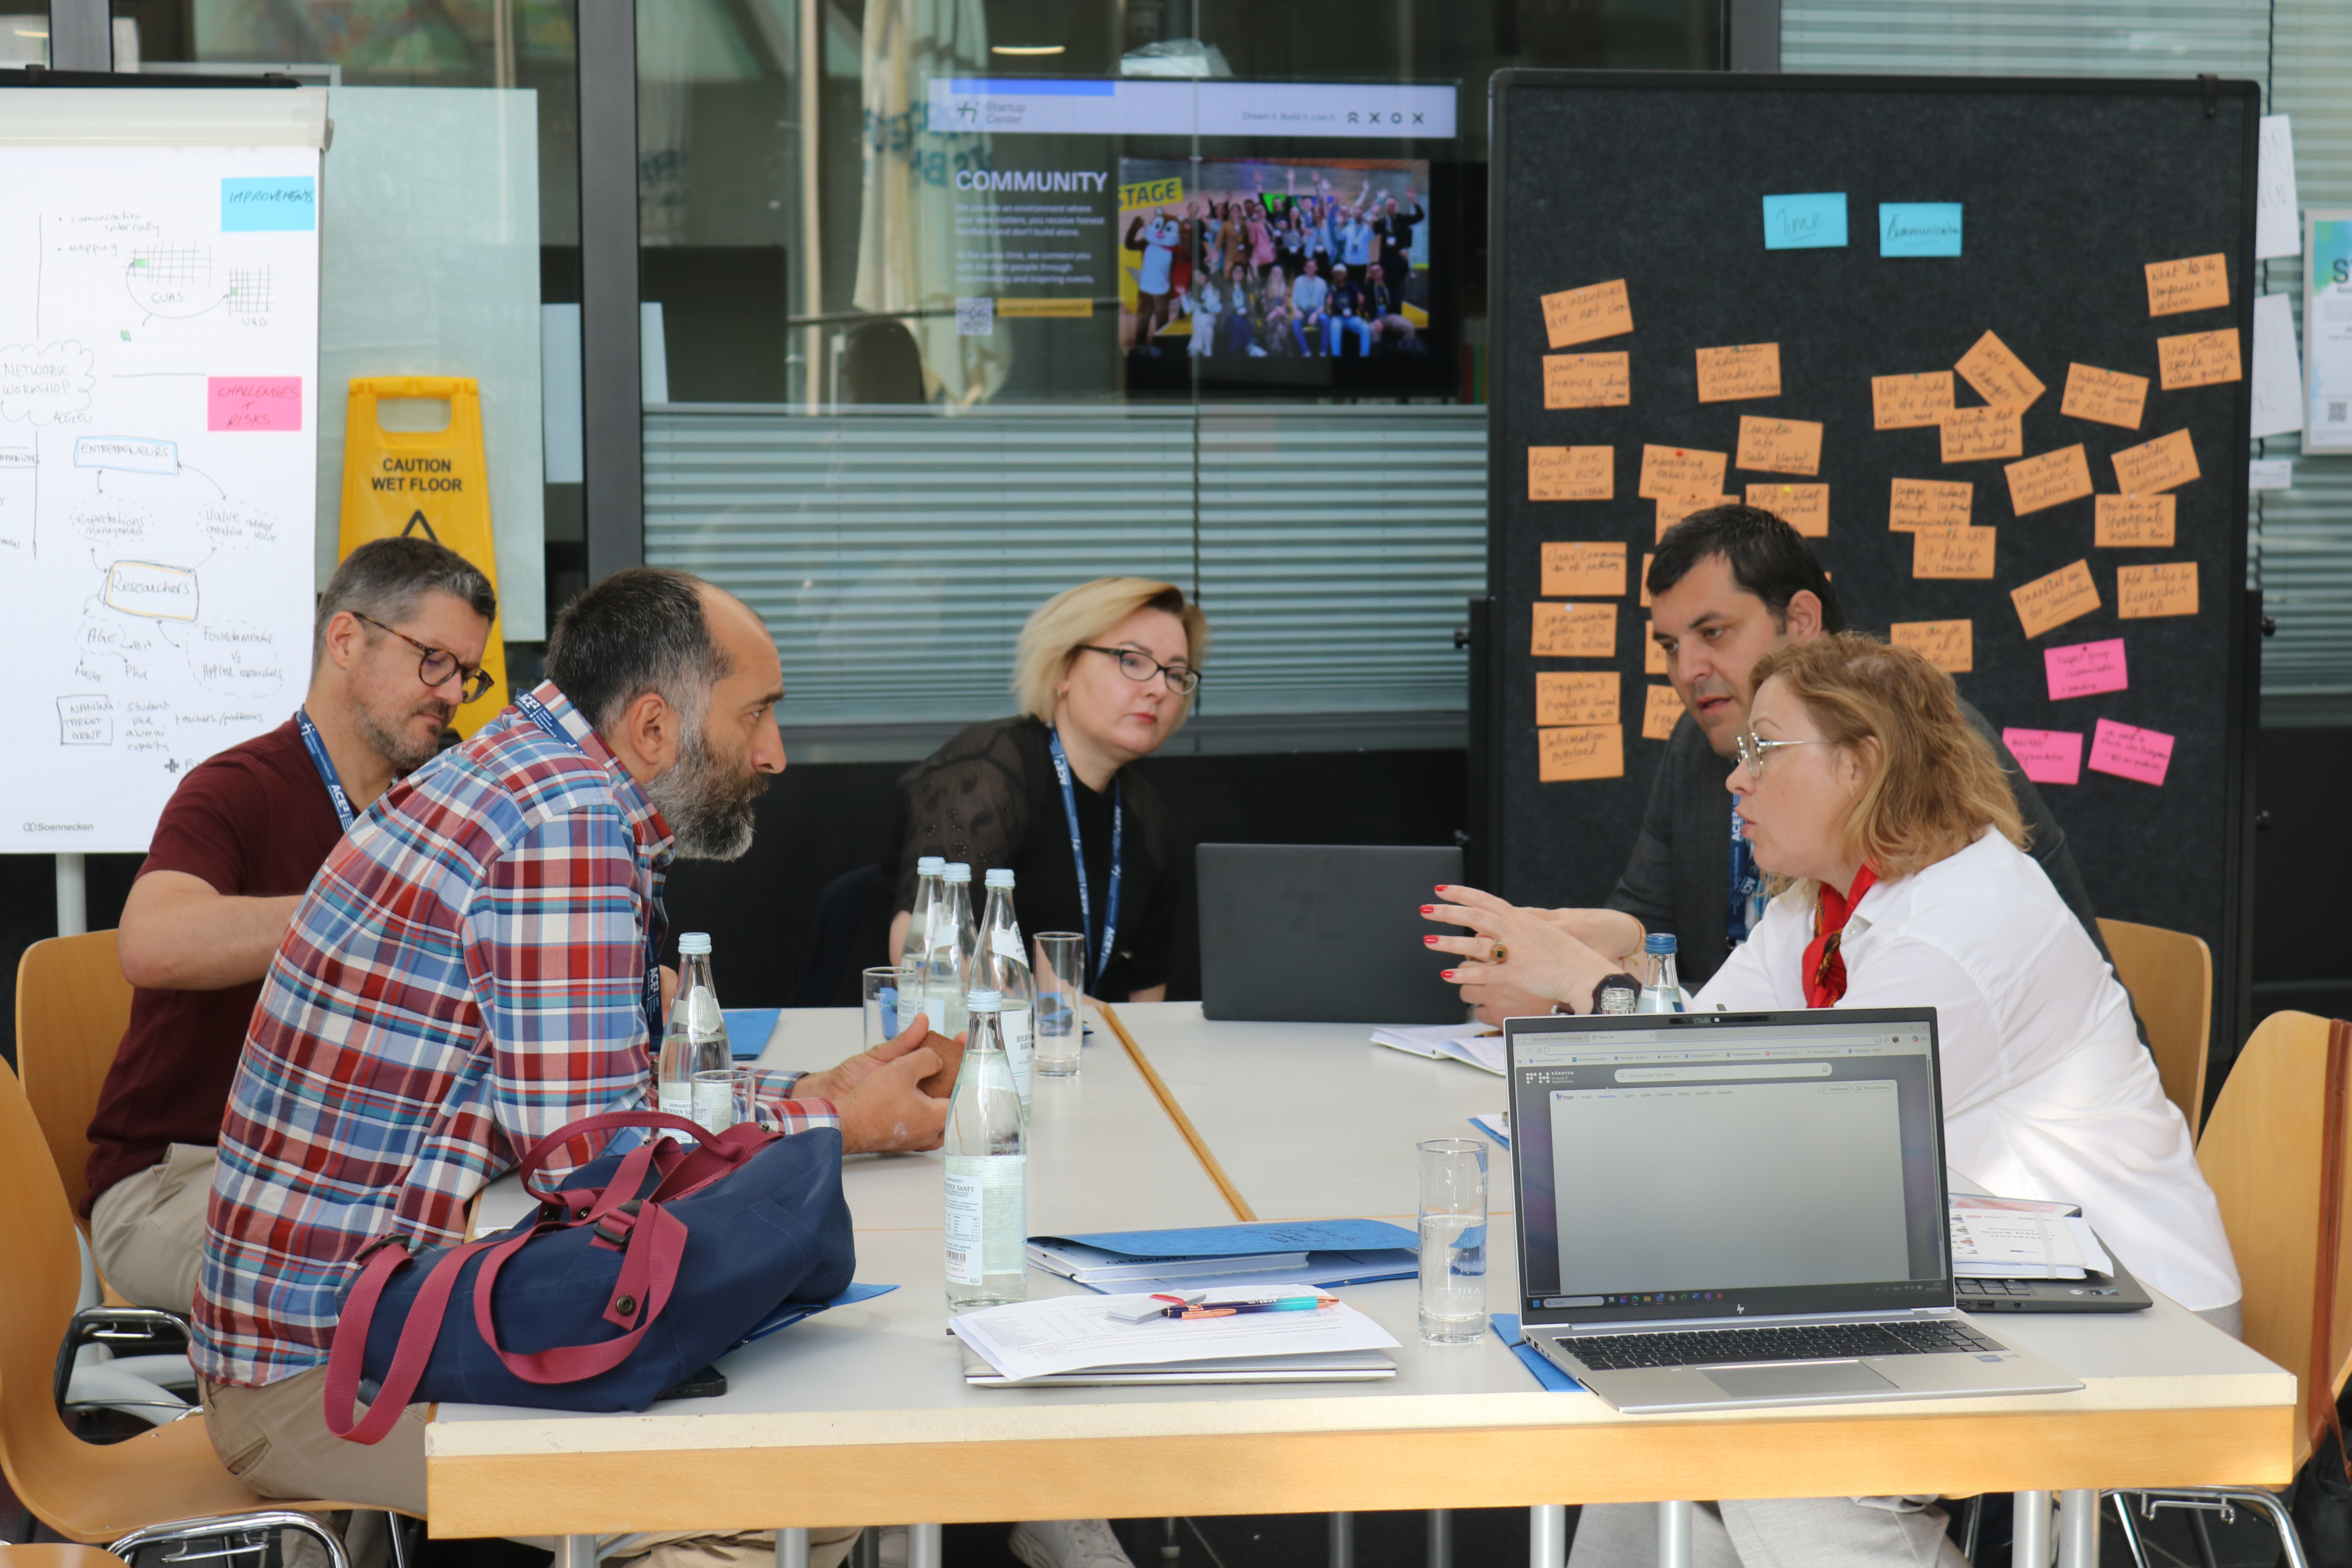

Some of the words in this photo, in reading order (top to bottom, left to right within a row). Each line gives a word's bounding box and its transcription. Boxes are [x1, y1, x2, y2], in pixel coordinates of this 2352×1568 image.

[986, 102, 1026, 113] Startup
[986, 115, 1022, 124] Center
[955, 171, 1108, 192] COMMUNITY
[230, 189, 314, 204] IMPROVEMENTS
[1775, 204, 1826, 236] Time
[69, 243, 118, 256] mapping
[151, 292, 184, 303] CUAS
[4, 362, 68, 377] NETWORK
[3, 381, 71, 394] WORKSHOP
[218, 385, 299, 399] CHALLENGES
[81, 443, 169, 457] ENTREPRENEURS
[383, 458, 451, 472] CAUTION
[372, 477, 405, 491] WET
[410, 479, 462, 492] FLOOR
[111, 571, 190, 595] Researchers
[72, 730, 102, 740] GROUP
[38, 822, 94, 831] Soennecken
